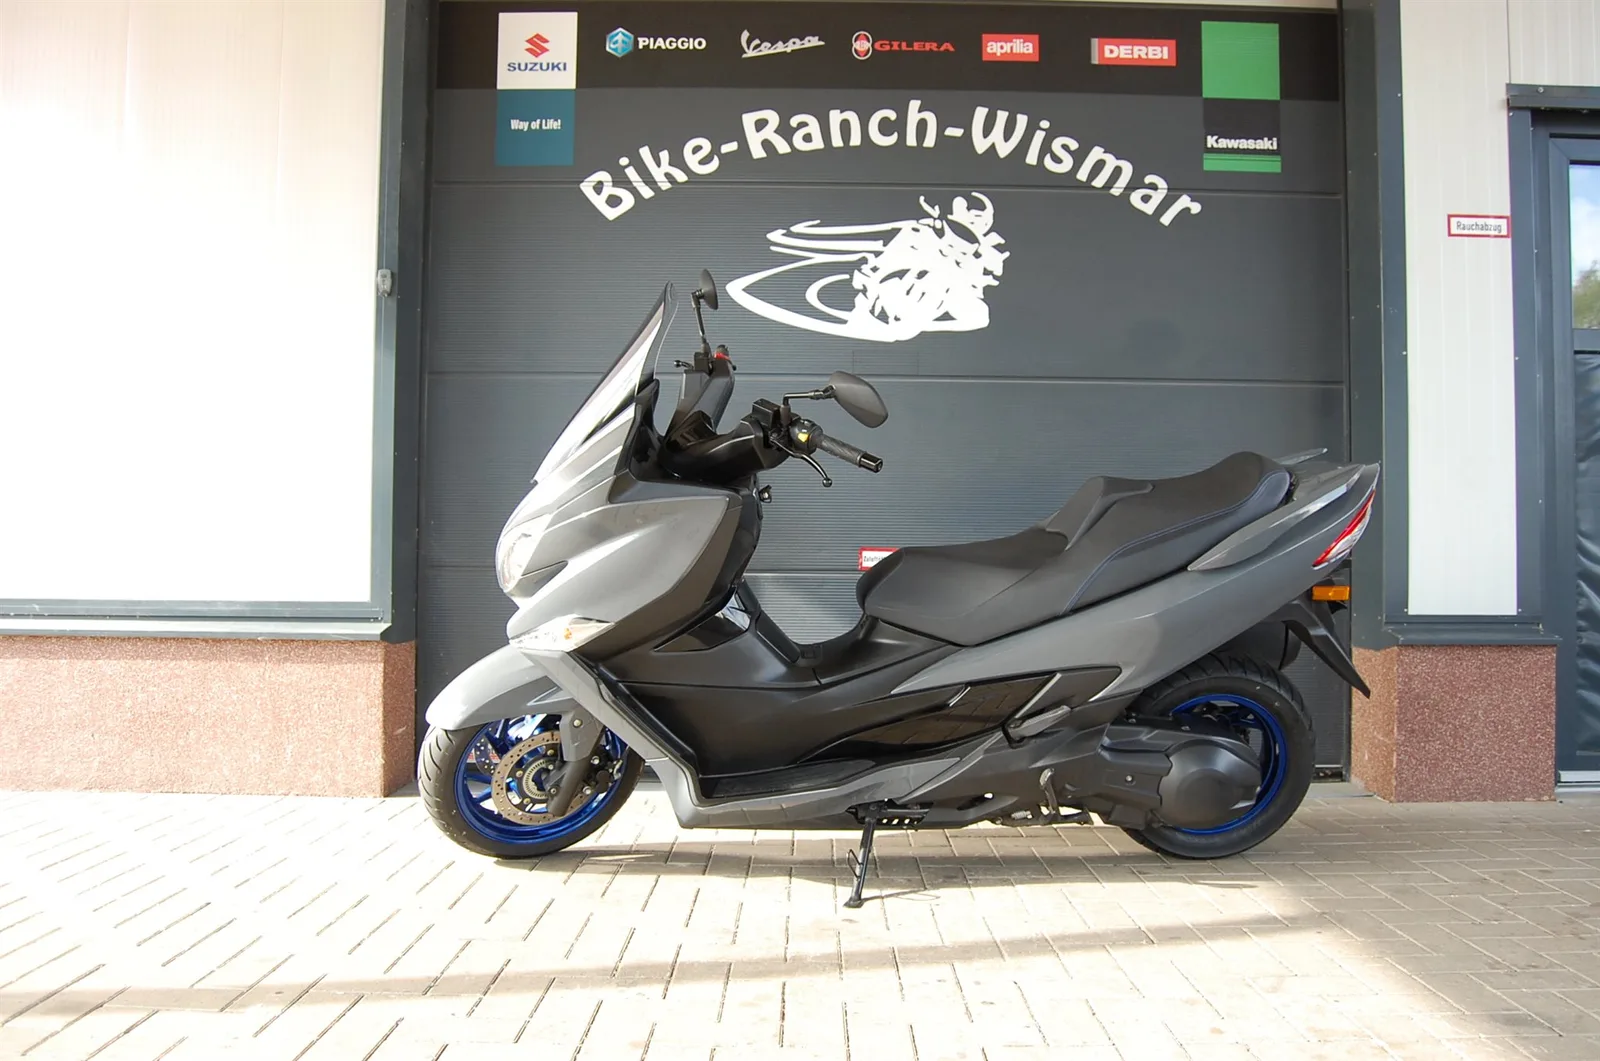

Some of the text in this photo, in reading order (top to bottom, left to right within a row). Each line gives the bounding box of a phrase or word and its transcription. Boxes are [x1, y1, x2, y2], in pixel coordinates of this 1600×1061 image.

[637, 37, 707, 50] PIAGGIO
[740, 29, 826, 58] Vespa
[874, 39, 956, 53] GILERA
[986, 38, 1034, 56] aprilia
[1104, 44, 1169, 60] DERBI
[507, 62, 567, 72] SUZUKI
[510, 119, 561, 132] Way of Life!
[1206, 135, 1278, 150] Kawasaki
[579, 99, 1202, 227] Bike-Ranch-Wismar
[1456, 220, 1502, 233] Rauchabzug
